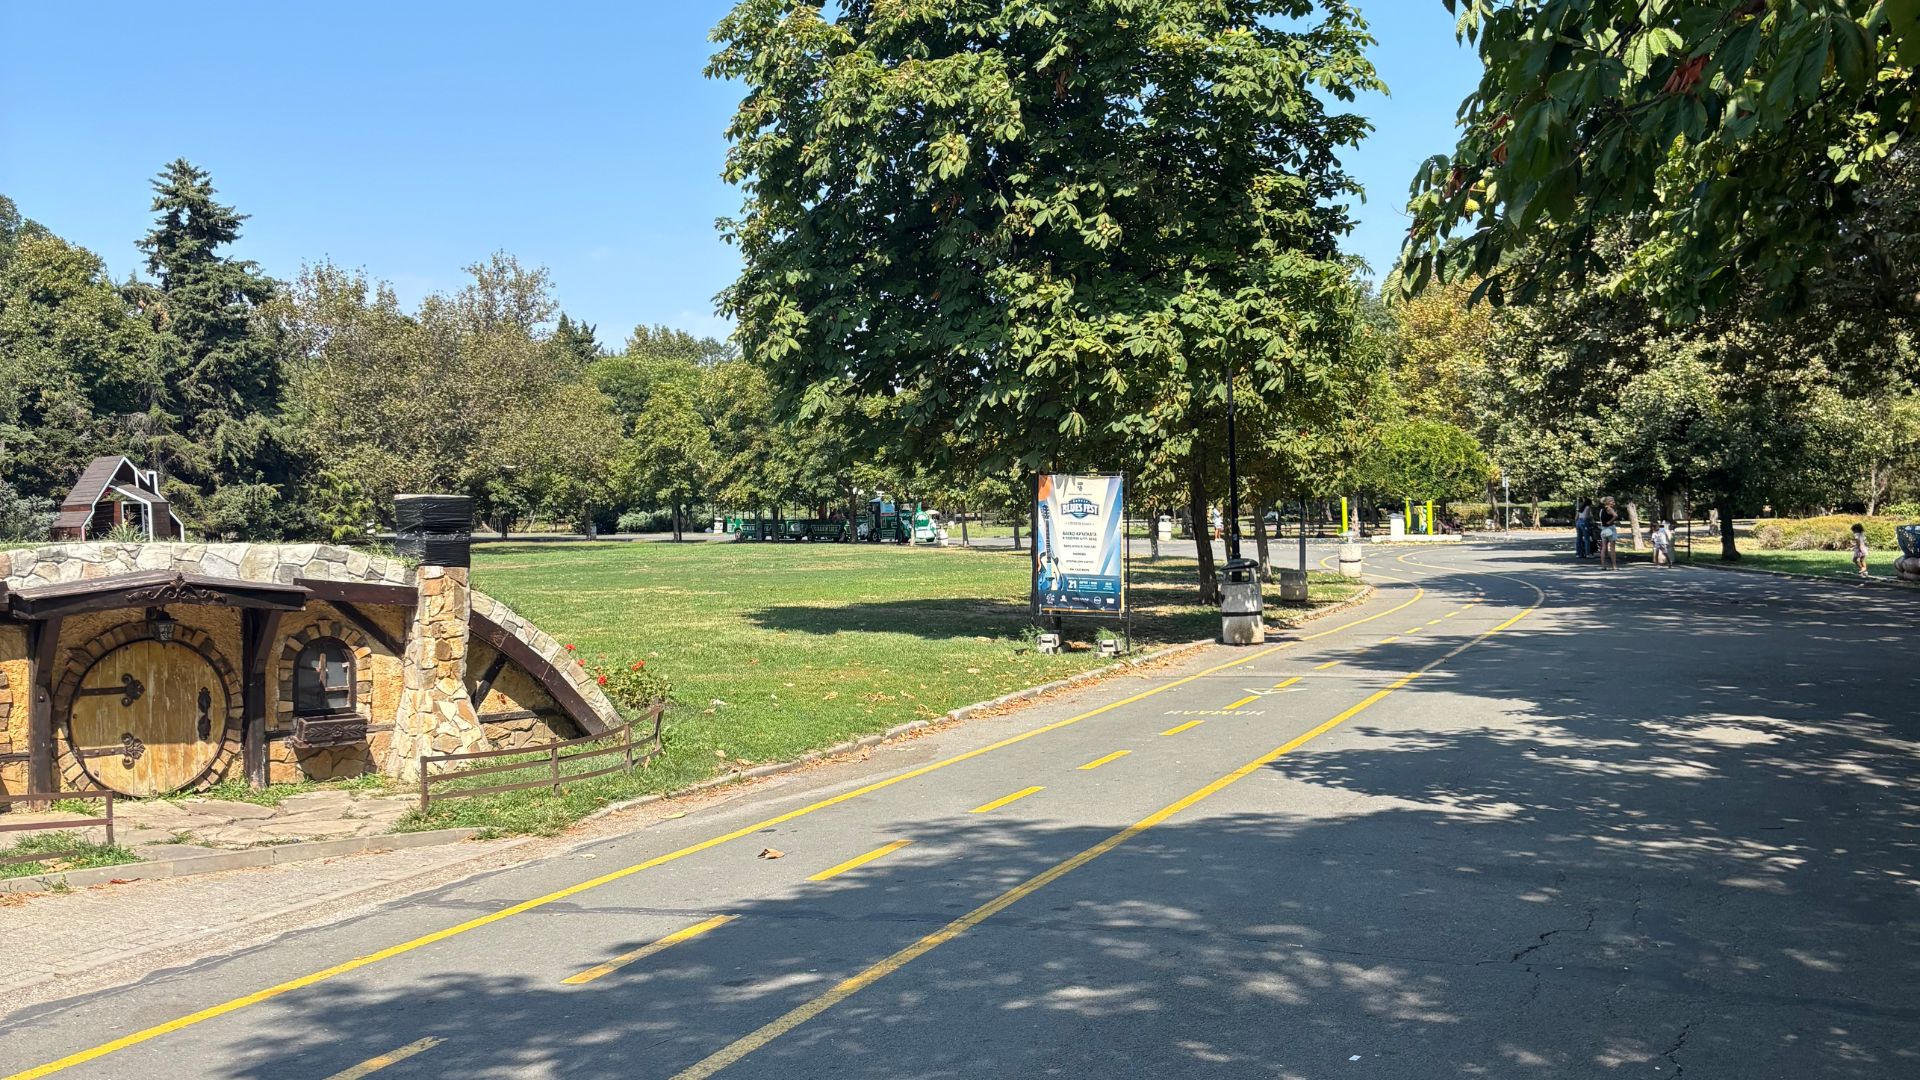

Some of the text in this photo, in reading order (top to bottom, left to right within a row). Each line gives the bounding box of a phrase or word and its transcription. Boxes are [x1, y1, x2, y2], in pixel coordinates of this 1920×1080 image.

[1062, 503, 1098, 515] BLUES FEST
[1068, 580, 1077, 588] 21
